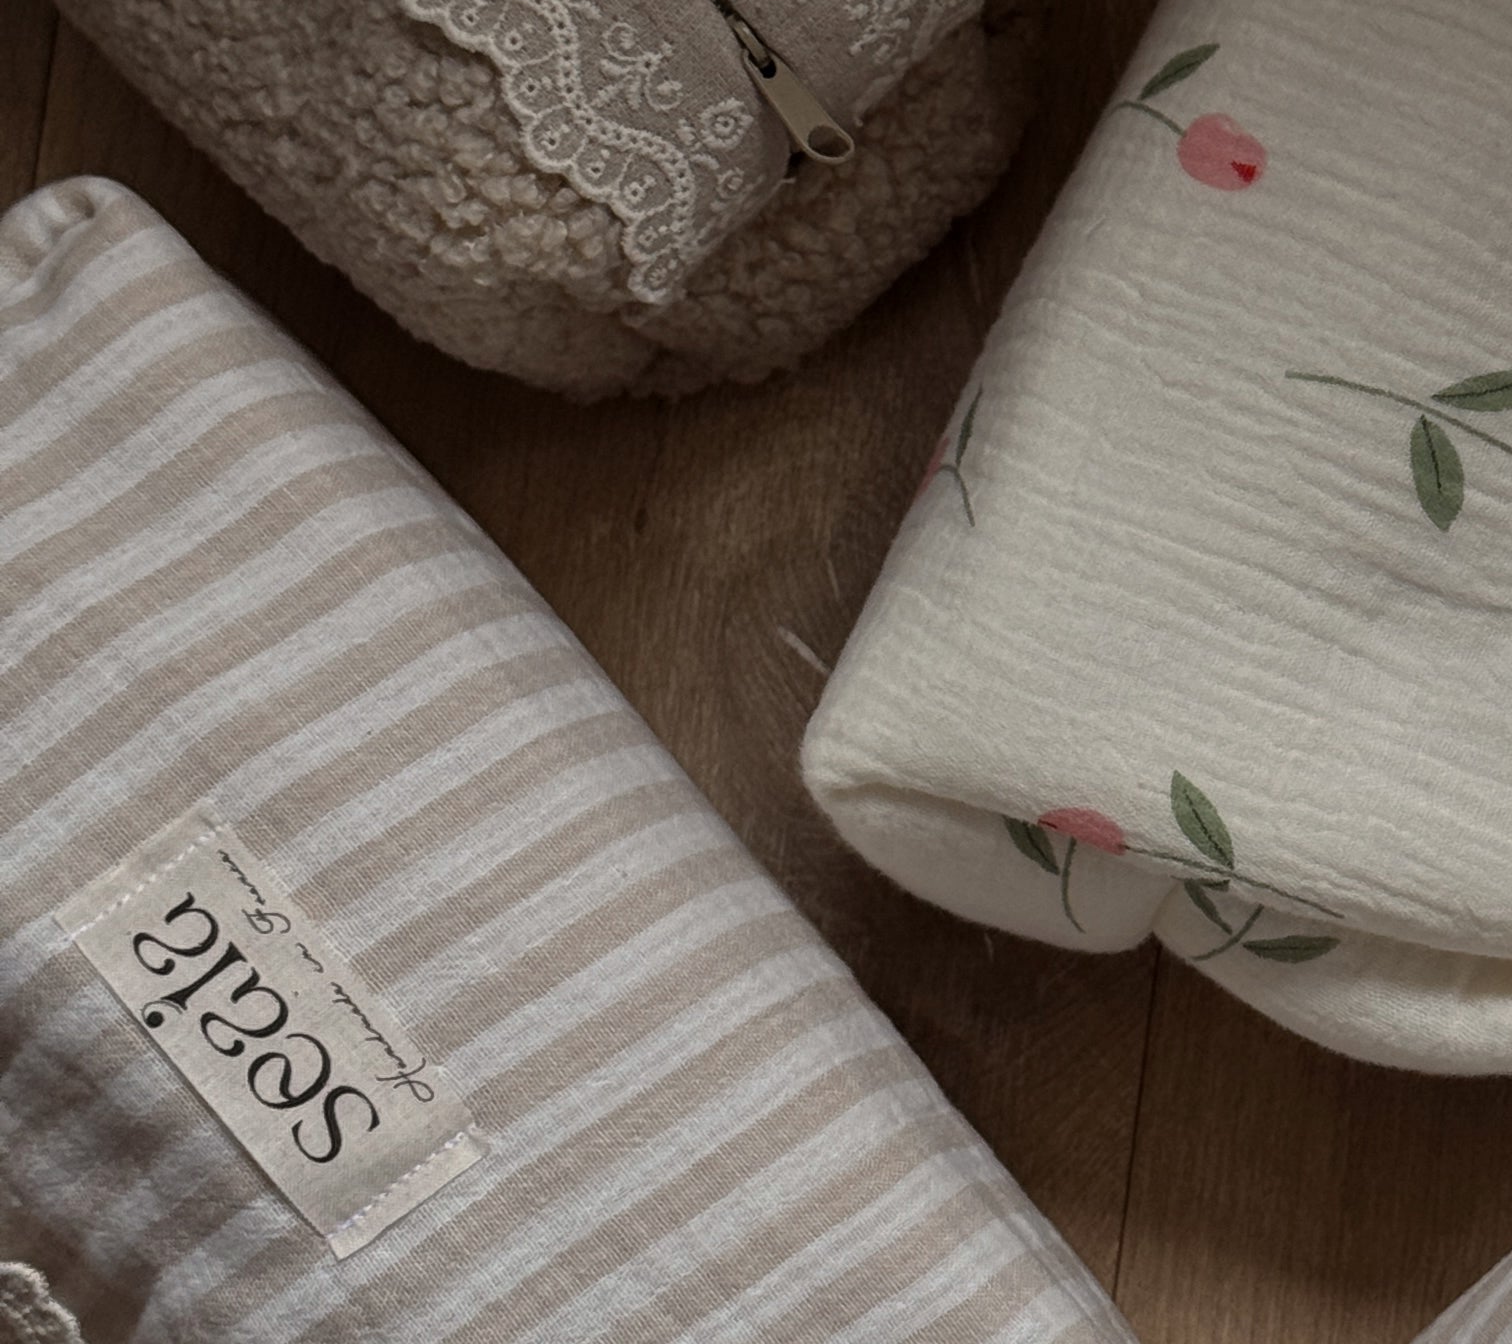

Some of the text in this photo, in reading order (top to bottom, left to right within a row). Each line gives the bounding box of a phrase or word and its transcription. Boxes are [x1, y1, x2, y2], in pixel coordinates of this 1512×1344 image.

[132, 892, 380, 1163] seaia
[219, 849, 434, 1102] Handmade in France
